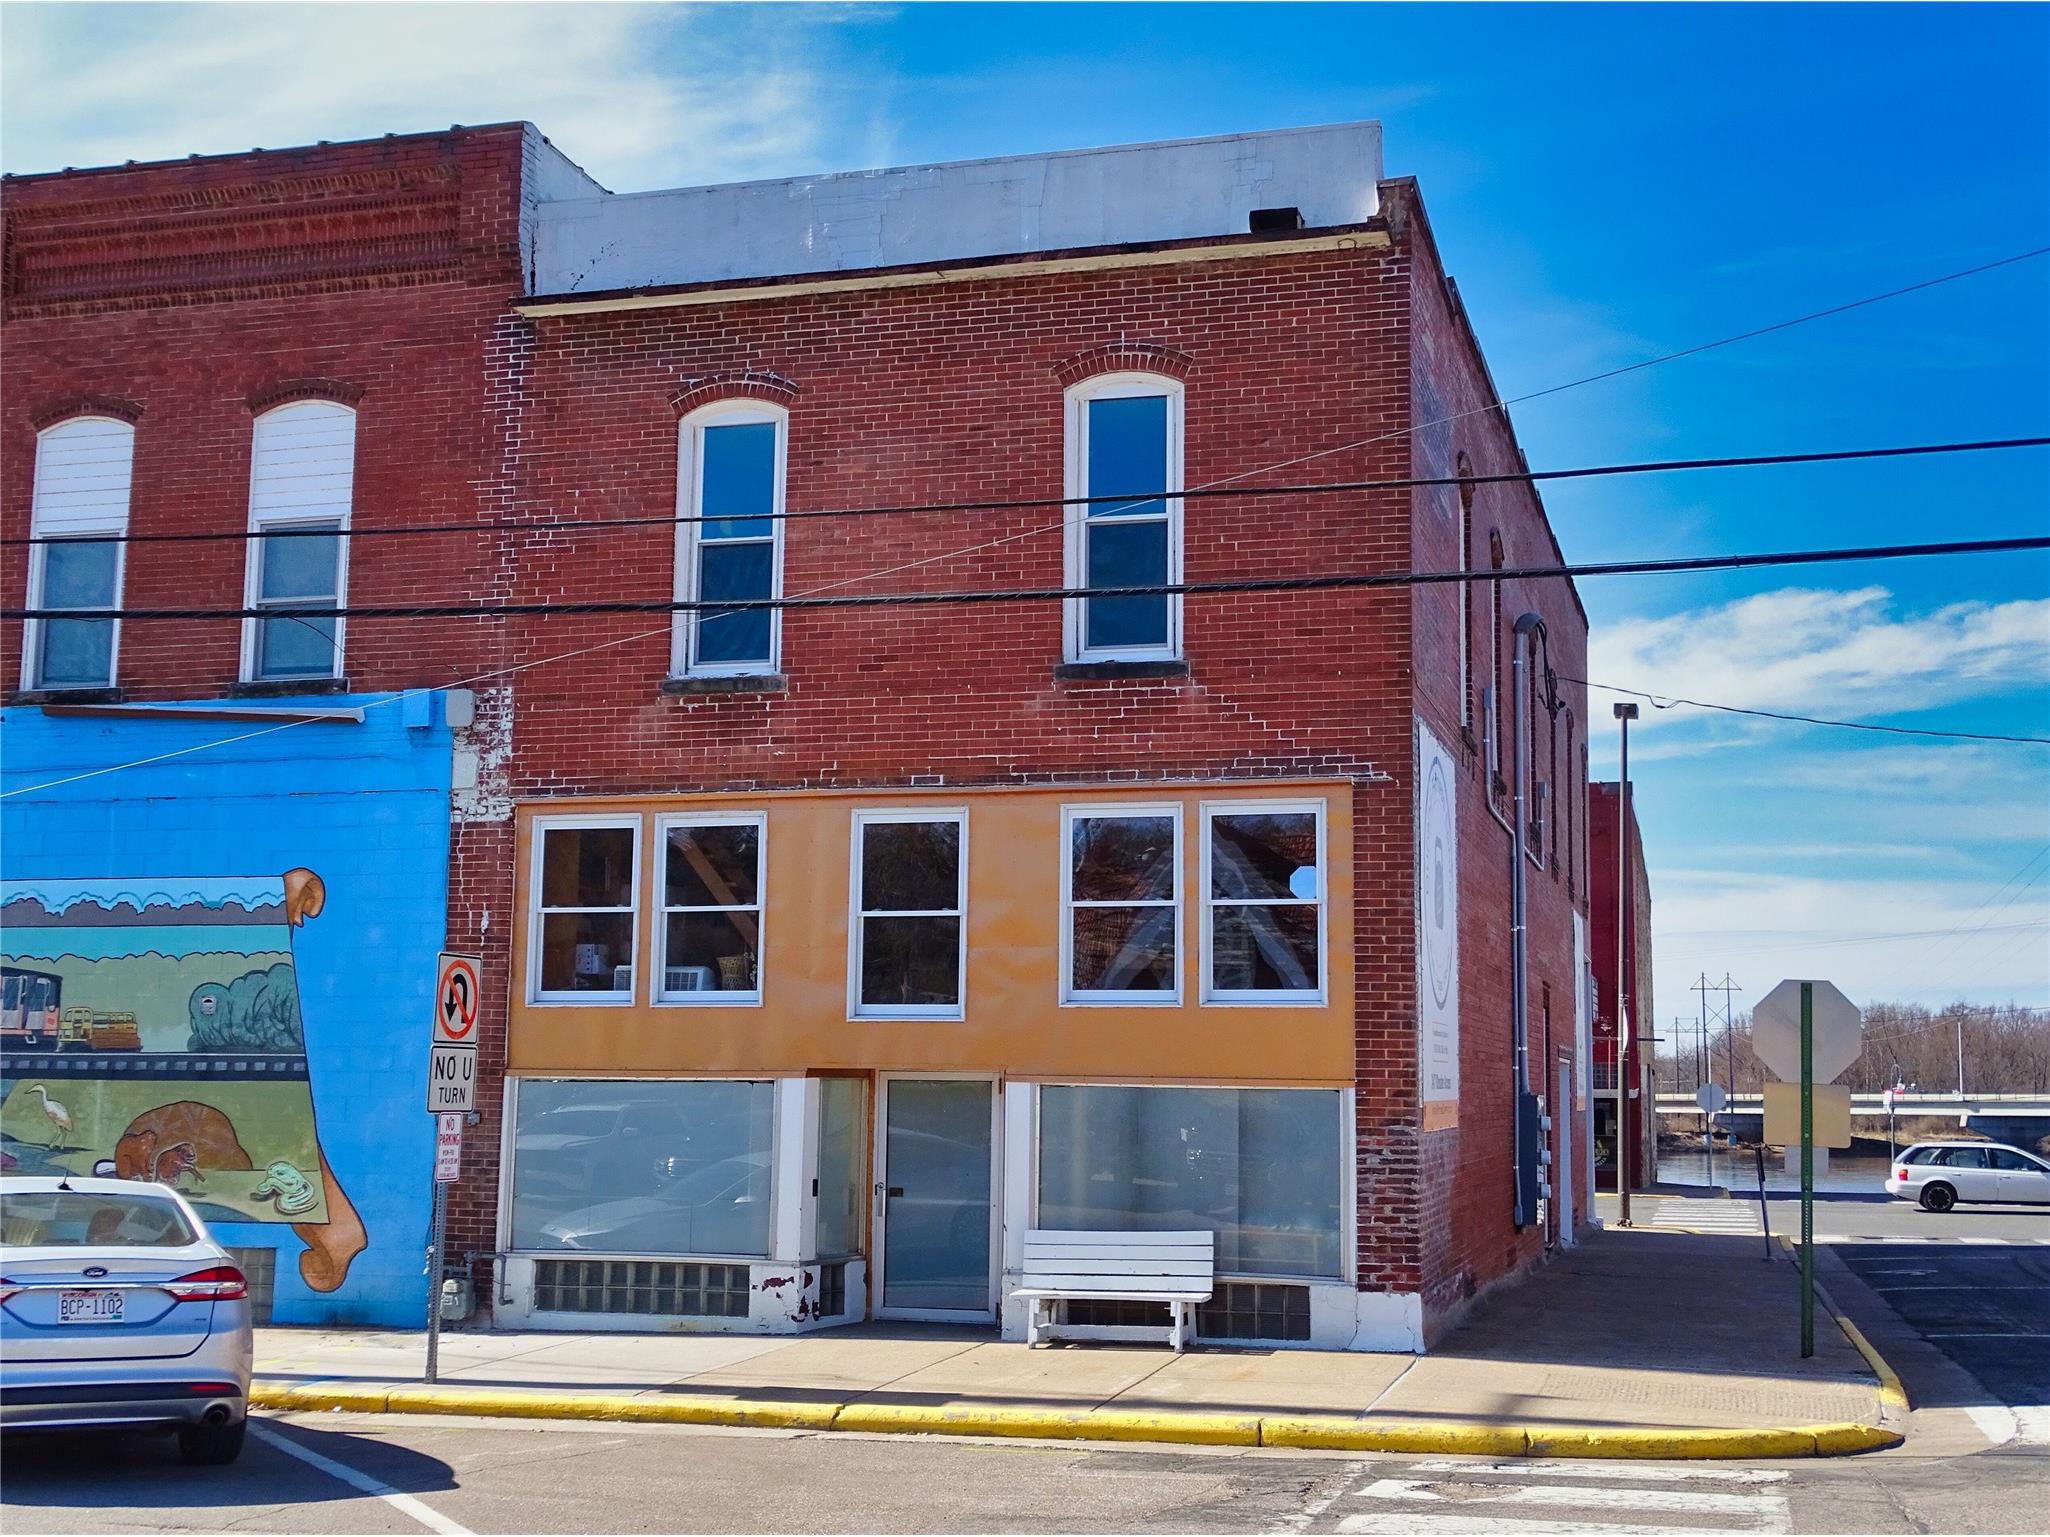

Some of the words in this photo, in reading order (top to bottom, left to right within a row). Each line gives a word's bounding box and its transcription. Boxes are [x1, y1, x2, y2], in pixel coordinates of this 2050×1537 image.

[435, 1057, 456, 1081] NO
[463, 1058, 472, 1081] U
[439, 1087, 466, 1104] TURN
[446, 1119, 455, 1131] NO
[440, 1134, 460, 1145] PARKING
[61, 1299, 123, 1315] BCP-1102
